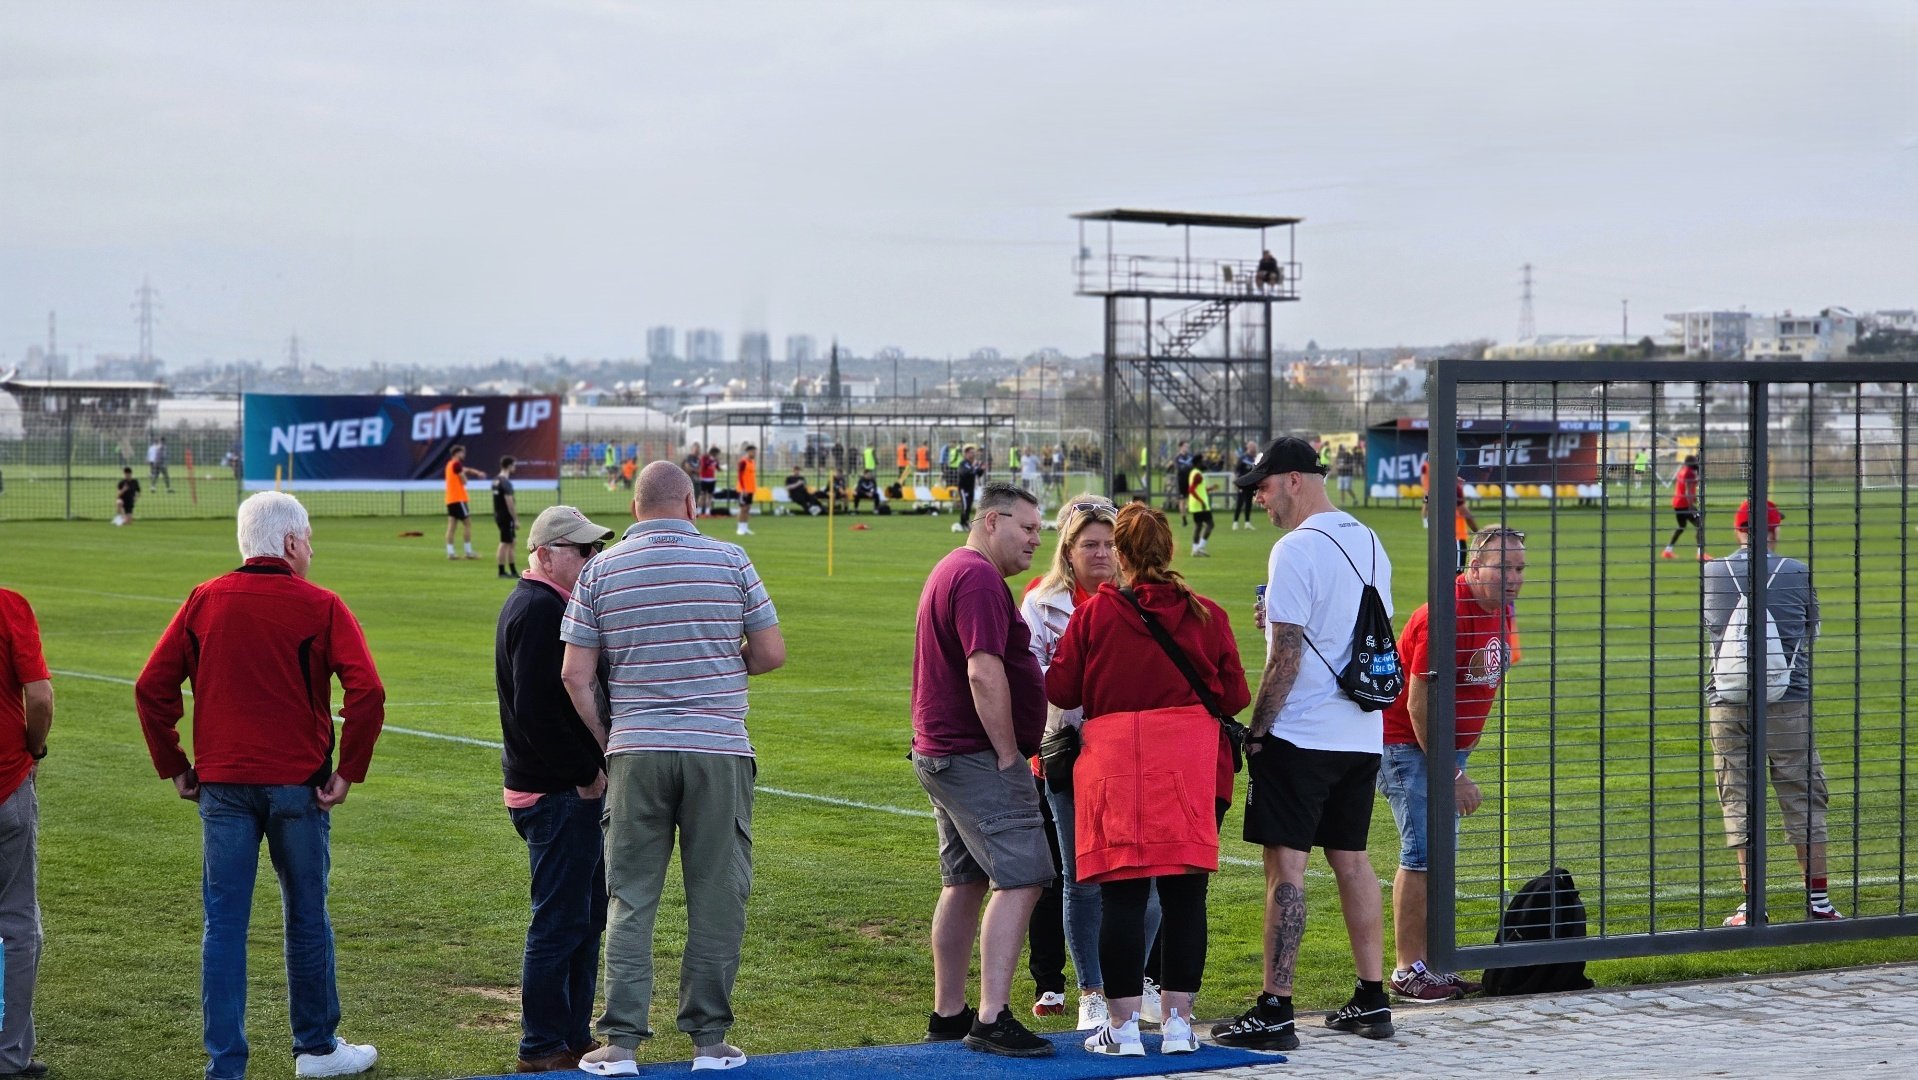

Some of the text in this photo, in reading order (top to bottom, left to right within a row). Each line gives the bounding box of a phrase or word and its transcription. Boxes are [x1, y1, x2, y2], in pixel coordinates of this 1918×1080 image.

[270, 399, 551, 455] NEVER GIVE UP
[1558, 421, 1584, 431] NEVER
[1377, 433, 1580, 482] NEV GIVE UP
